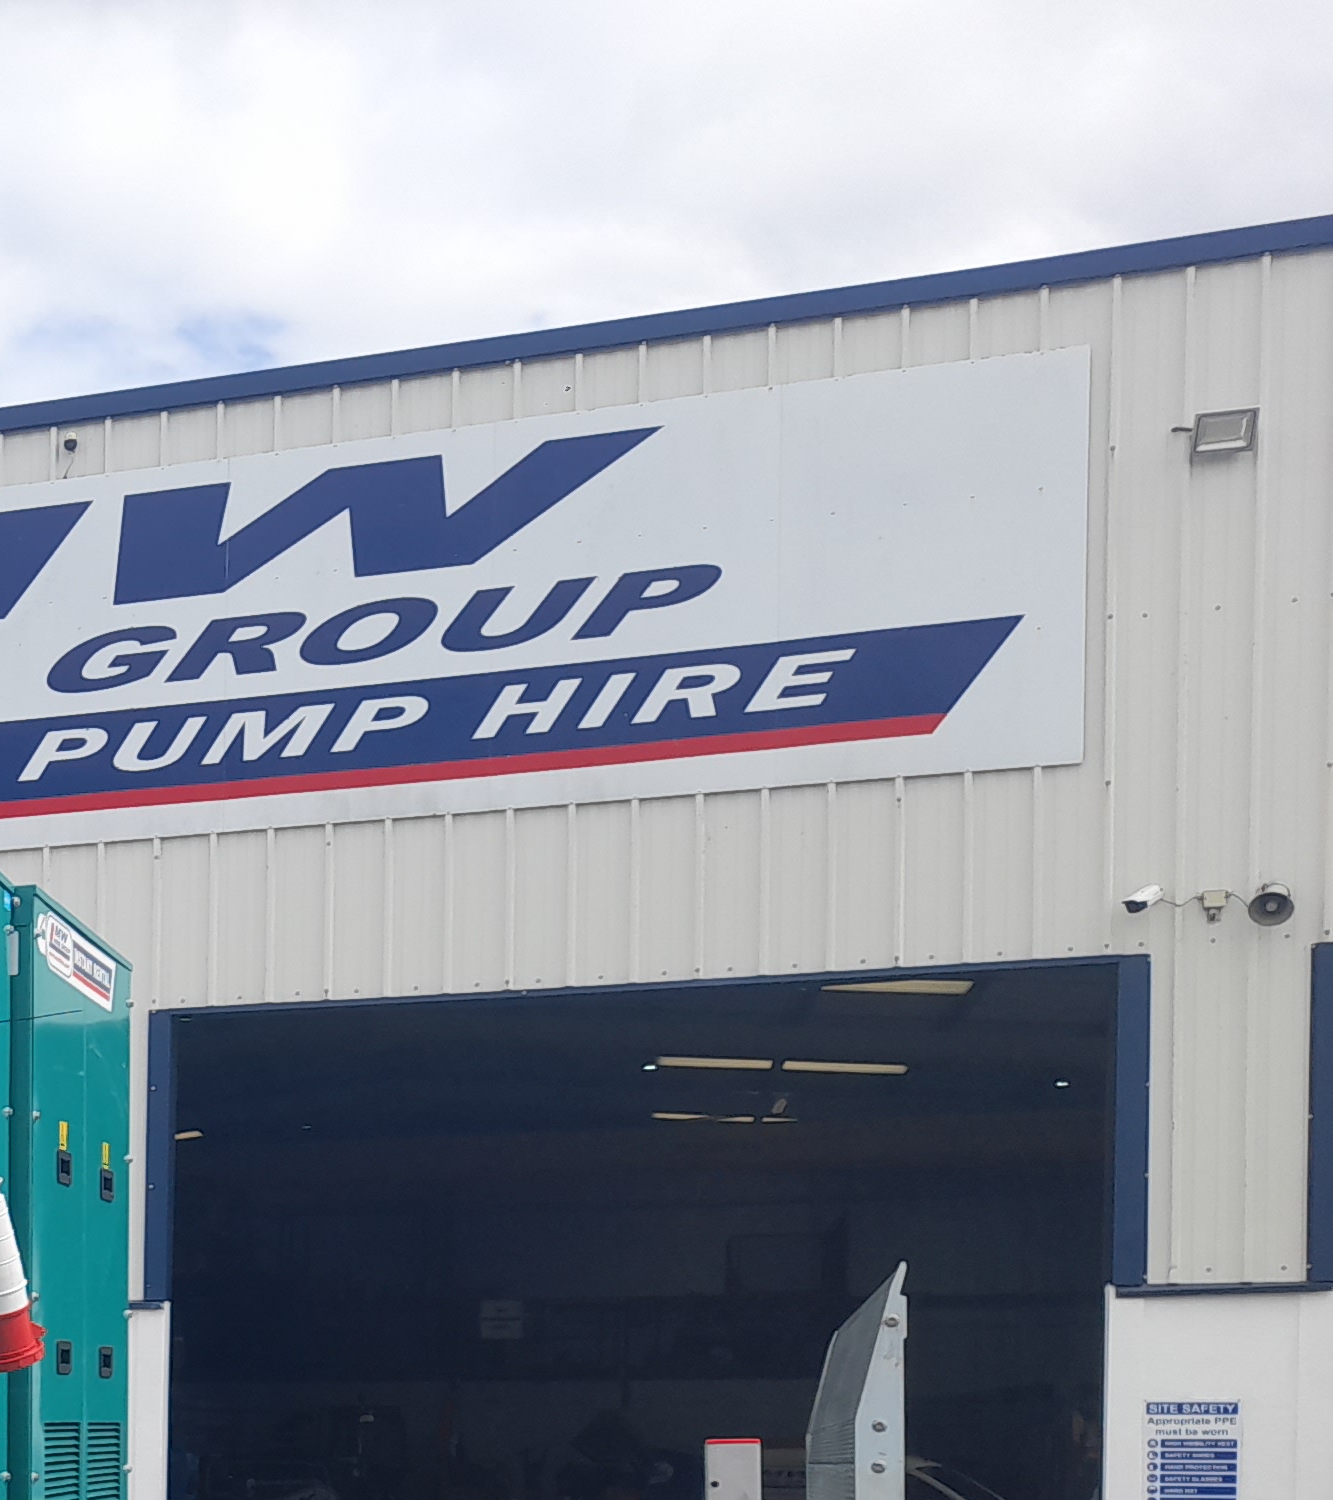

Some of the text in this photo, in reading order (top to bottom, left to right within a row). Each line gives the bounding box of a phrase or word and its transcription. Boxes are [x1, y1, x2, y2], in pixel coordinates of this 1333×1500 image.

[46, 564, 722, 694] GROUP
[16, 695, 430, 783] PUMP
[471, 648, 857, 740] HIRE
[1148, 1403, 1235, 1414] SITE SAFETY
[1147, 1417, 1237, 1426] Appropriate PPE
[1155, 1428, 1182, 1436] must
[1185, 1428, 1198, 1436] be
